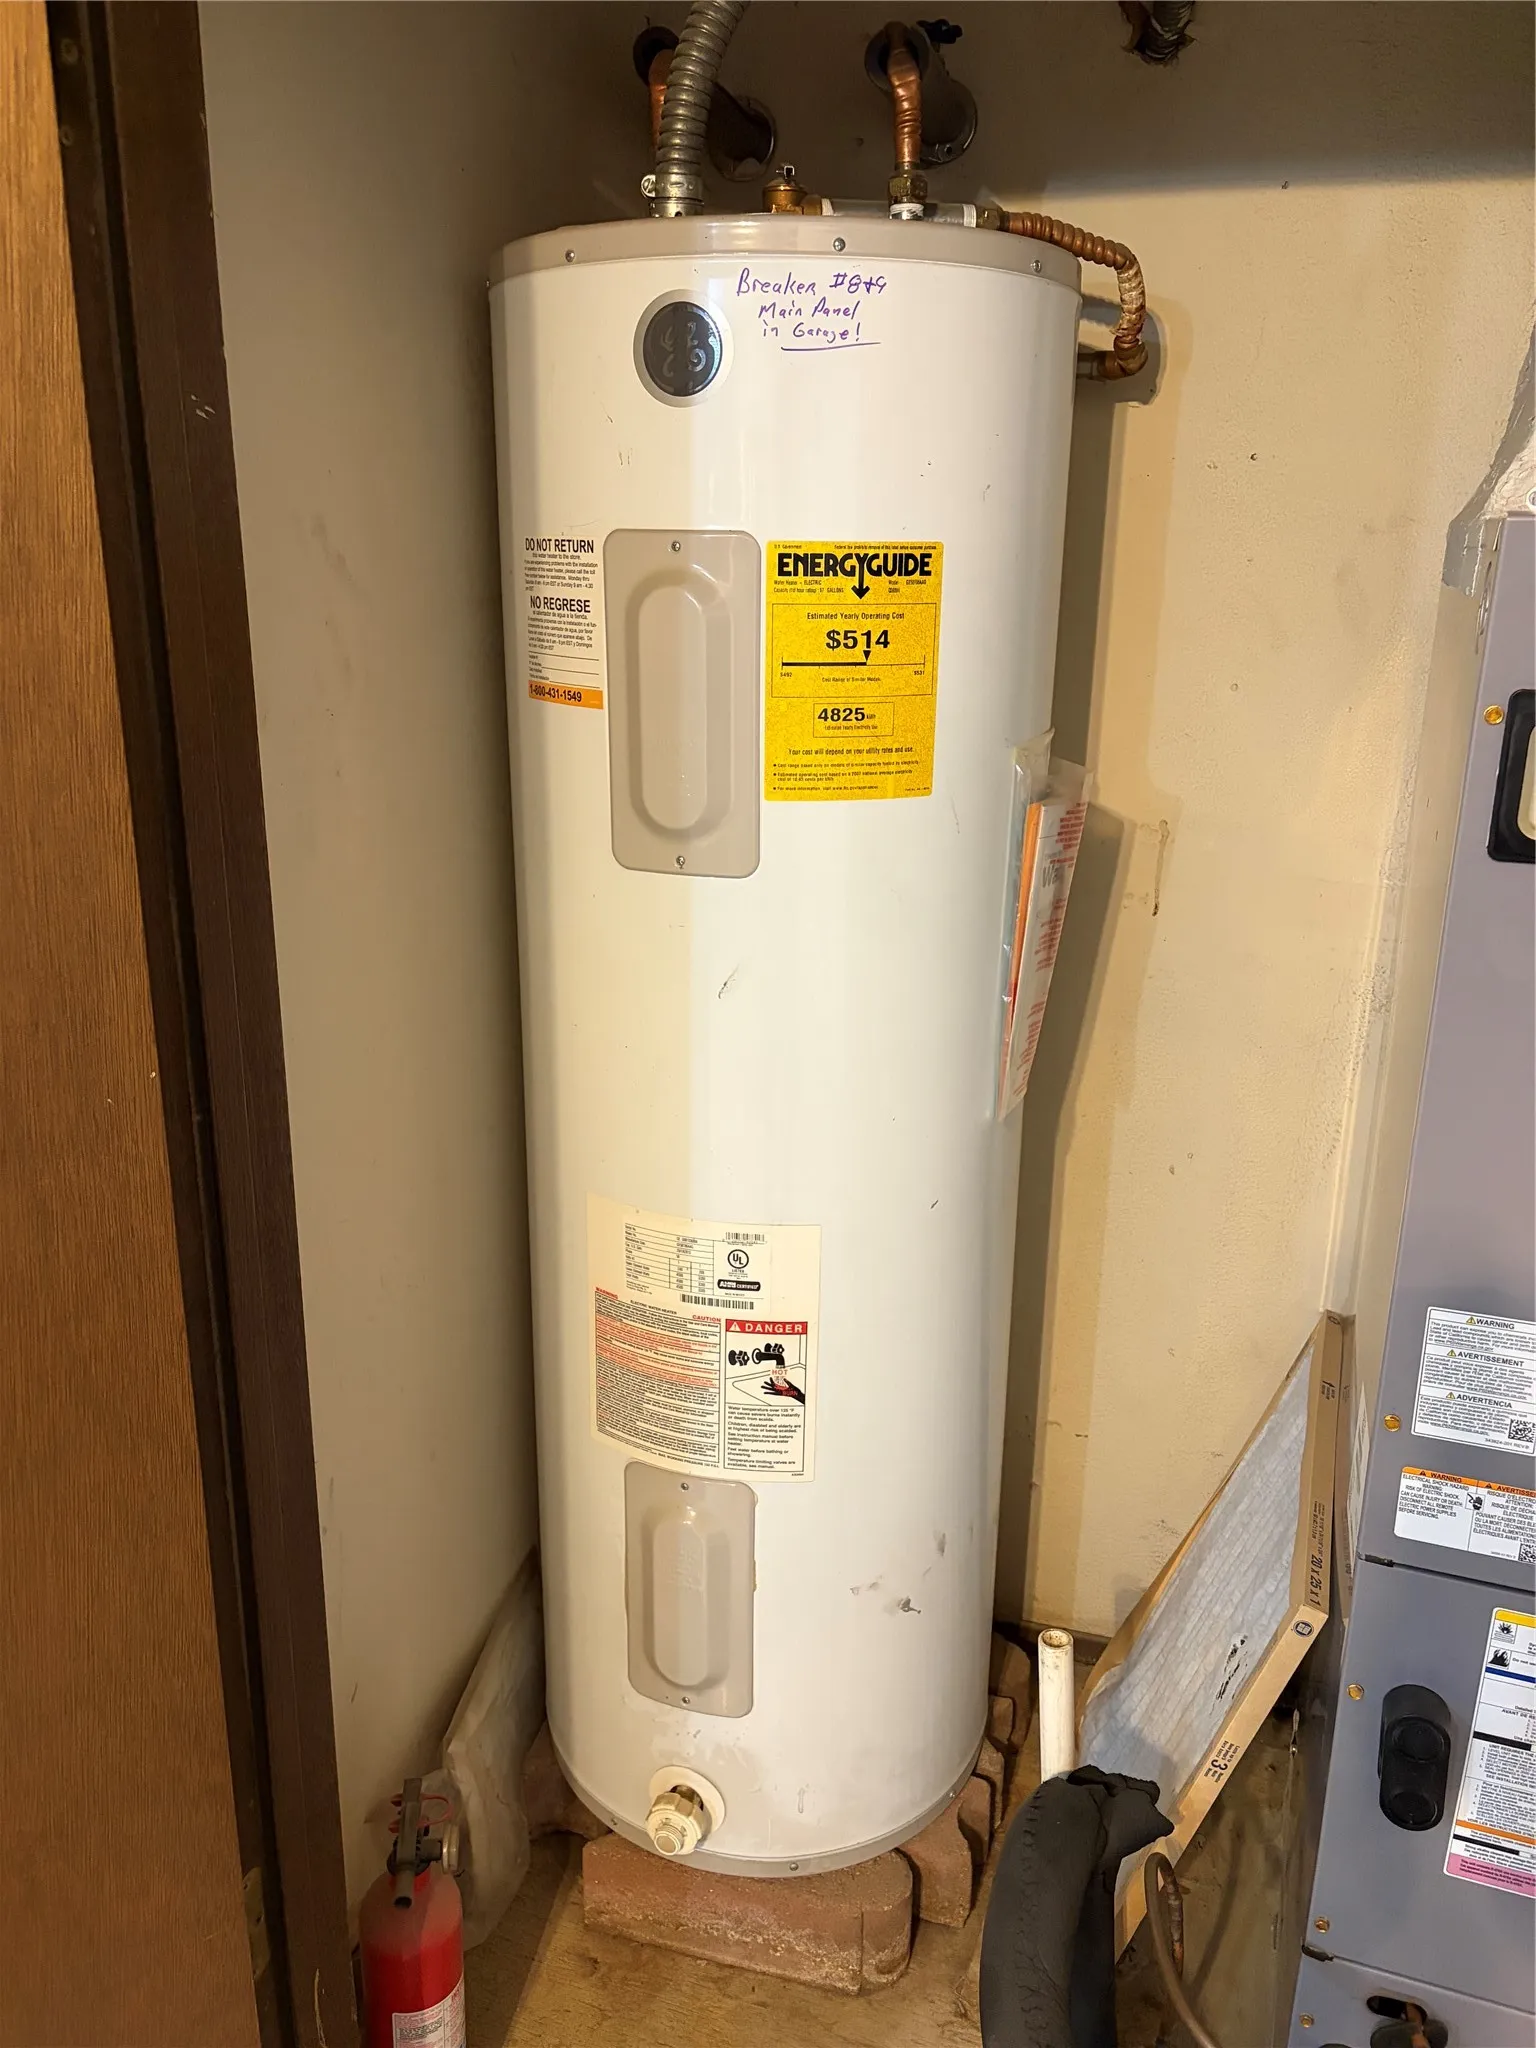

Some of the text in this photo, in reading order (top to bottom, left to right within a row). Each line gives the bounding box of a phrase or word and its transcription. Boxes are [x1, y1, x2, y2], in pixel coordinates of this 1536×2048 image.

[737, 268, 816, 296] Breaker
[758, 296, 860, 319] Main Panel
[763, 320, 861, 343] in Garage!
[526, 538, 594, 553] DO NOT RETURN
[530, 596, 590, 613] NO REGRESE
[826, 629, 890, 651] $514
[530, 684, 581, 702] 1-800-431-1549
[818, 708, 865, 722] 4825
[733, 1253, 743, 1265] UL
[596, 1287, 618, 1300] WARNING
[630, 1300, 647, 1308] ELECTRIC
[746, 1323, 803, 1333] DANGER
[1476, 1318, 1515, 1329] WARNING
[1458, 1351, 1524, 1367] AVERTISSEMENT
[1457, 1394, 1512, 1409] ADVERTENCIA
[1403, 1474, 1431, 1484] ELECTRICAL
[1449, 1483, 1469, 1491] HAZARD
[1431, 1472, 1462, 1483] WARNING
[1423, 1489, 1443, 1497] ELECTRIC
[1400, 1496, 1427, 1505] DISCONNECT
[1436, 1502, 1453, 1511] REMOTE
[1436, 1509, 1456, 1517] SUPPLIES
[1311, 1554, 1323, 1570] 20
[1310, 1575, 1322, 1590] 25
[1312, 1596, 1321, 1607] 1
[1211, 1759, 1228, 1770] 3
